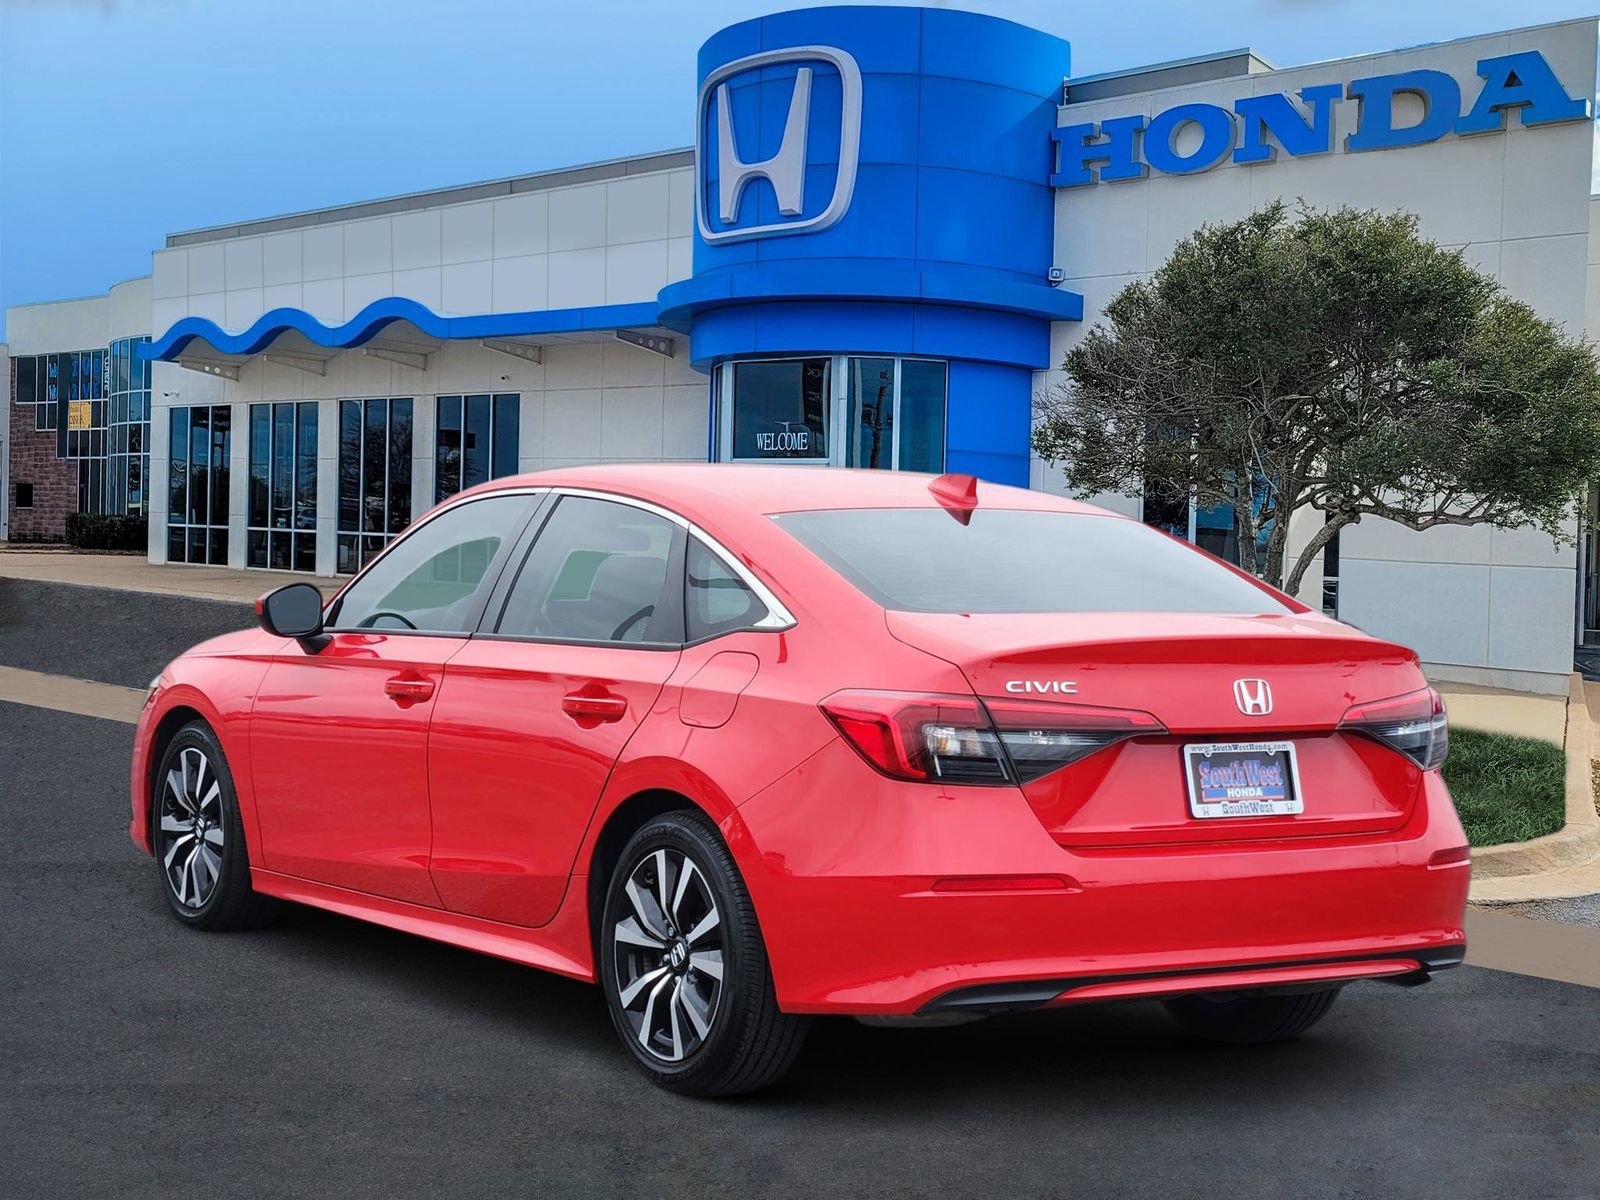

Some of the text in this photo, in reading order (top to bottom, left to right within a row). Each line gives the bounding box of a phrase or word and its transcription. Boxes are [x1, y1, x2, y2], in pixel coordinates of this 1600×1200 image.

[1050, 50, 1591, 187] HONDA
[756, 432, 808, 451] WELCOME
[1005, 681, 1078, 693] CIVIC
[1227, 788, 1263, 798] HONDA
[1222, 803, 1274, 815] SouthWest
